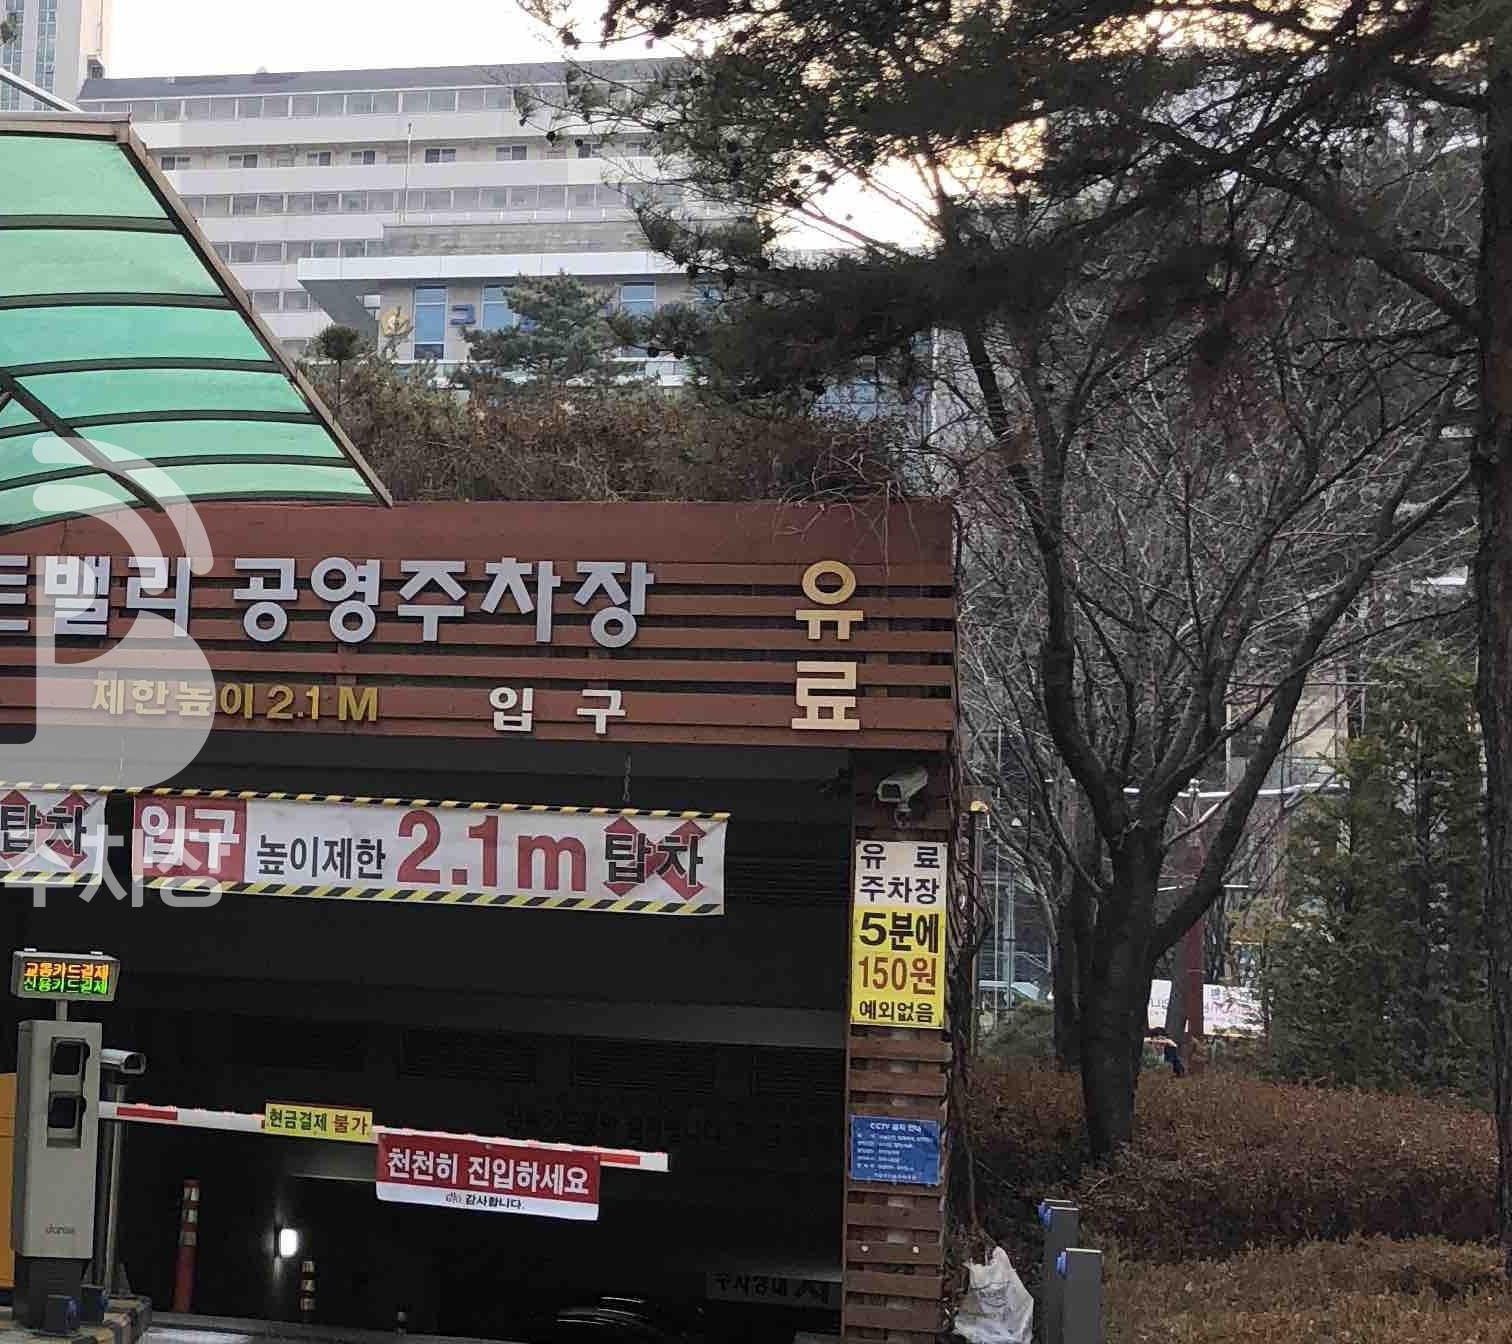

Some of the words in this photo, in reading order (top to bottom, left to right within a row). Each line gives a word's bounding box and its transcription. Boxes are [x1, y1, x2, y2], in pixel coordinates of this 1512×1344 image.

[233, 557, 655, 649] 공영주차장
[91, 678, 254, 719] 제한높이
[140, 806, 241, 874] 입구
[257, 834, 386, 880] 높이제한
[397, 810, 587, 892] 2.1m
[603, 831, 704, 888] 탑차
[860, 877, 940, 905] 주차장
[859, 912, 939, 953] 5분에
[858, 957, 937, 995] 150원
[859, 1001, 934, 1024] 예외없음
[270, 1108, 327, 1132] 현금결제
[334, 1114, 368, 1136] 불가
[388, 1148, 458, 1184] 천천히
[467, 1156, 588, 1195] 진입하세요
